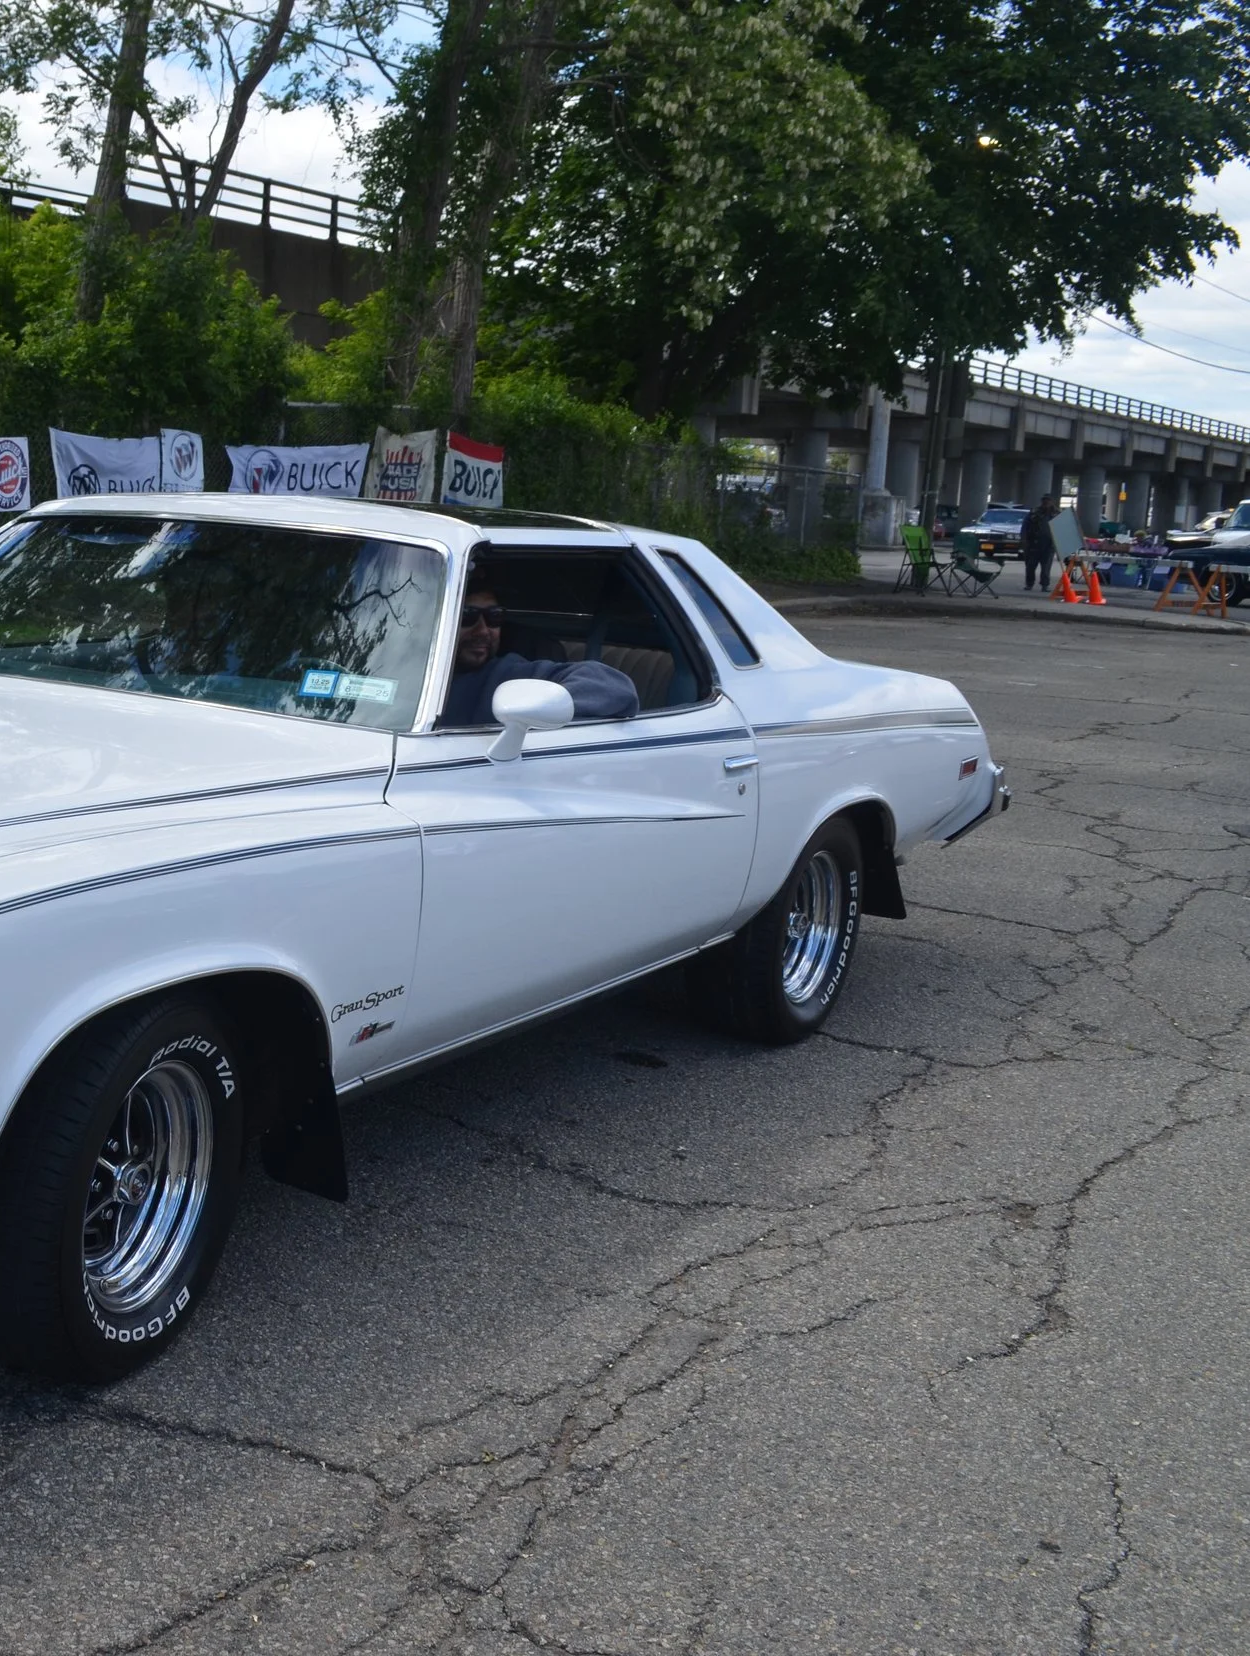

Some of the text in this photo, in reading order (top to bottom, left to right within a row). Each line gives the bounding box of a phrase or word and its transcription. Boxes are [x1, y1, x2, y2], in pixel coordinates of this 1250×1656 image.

[287, 459, 360, 491] BUICK
[388, 477, 416, 490] USA
[820, 870, 858, 1006] BFGoodrich
[362, 984, 405, 1011] Sport
[83, 1271, 191, 1343] BFGoodrich
